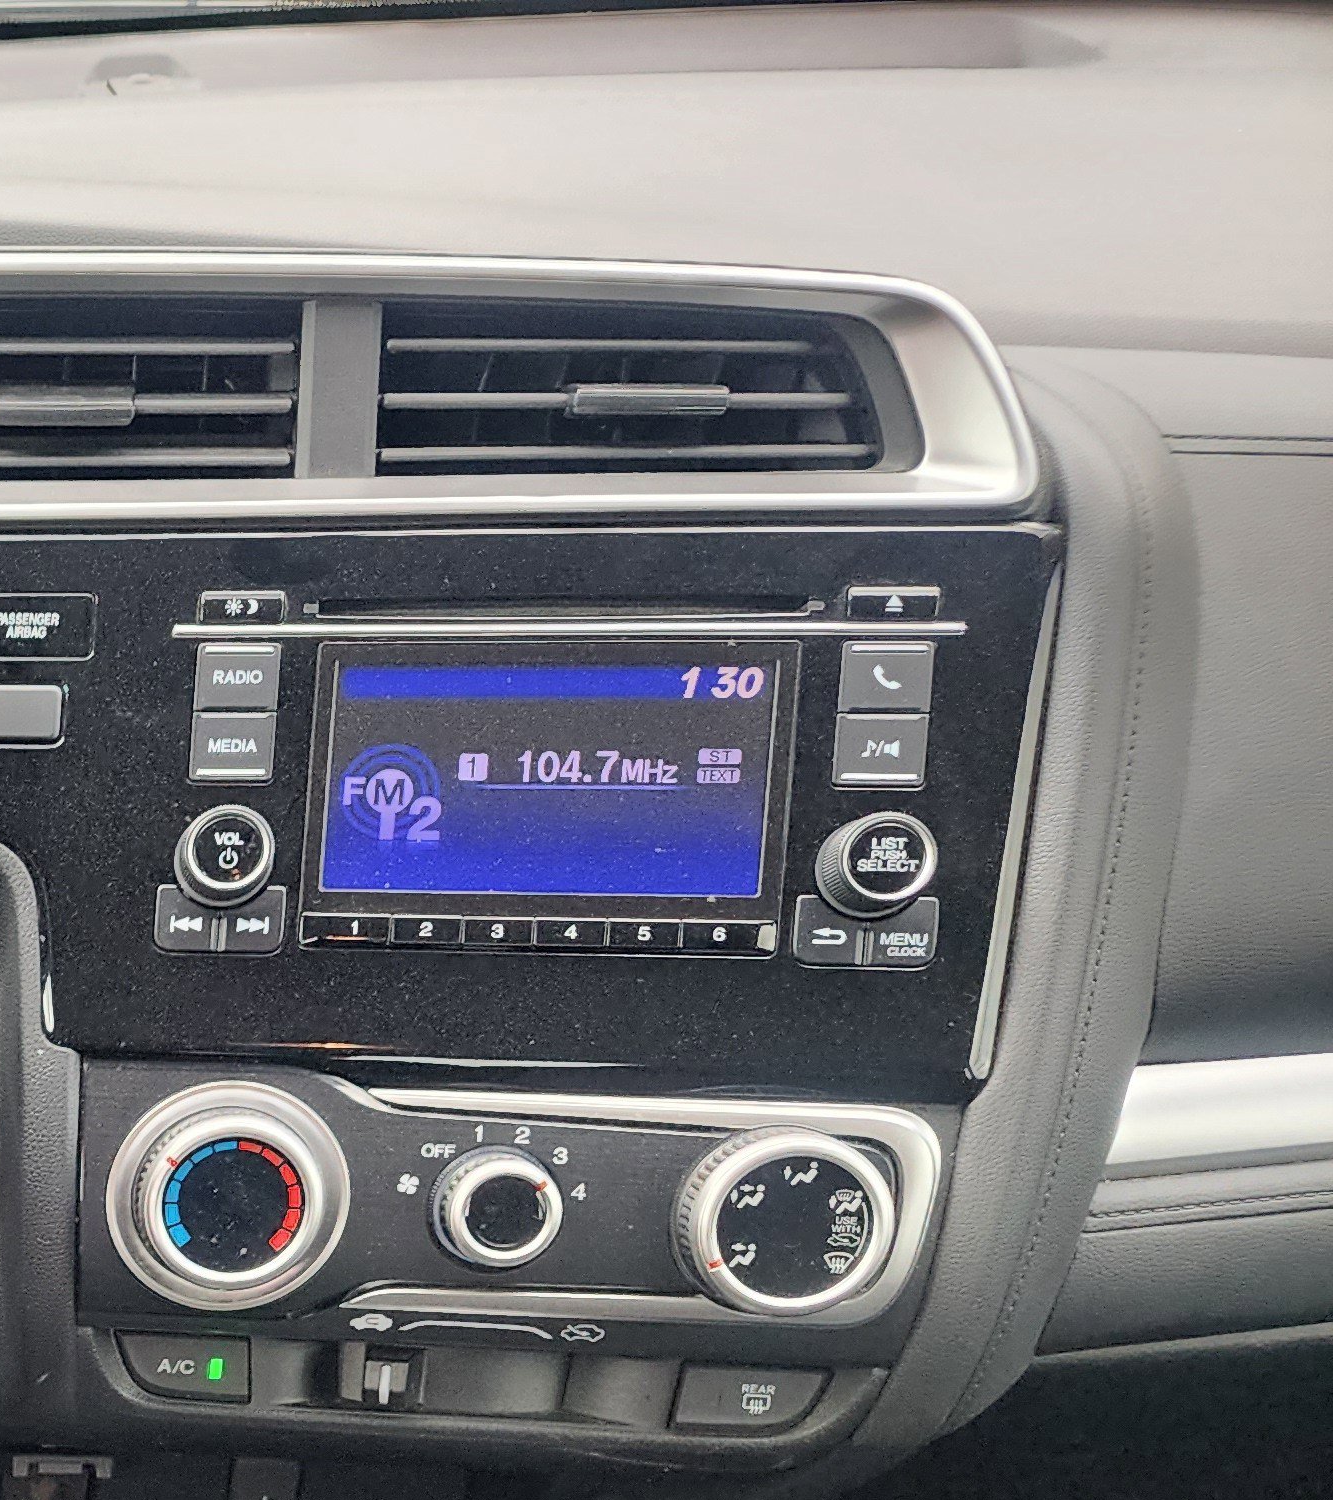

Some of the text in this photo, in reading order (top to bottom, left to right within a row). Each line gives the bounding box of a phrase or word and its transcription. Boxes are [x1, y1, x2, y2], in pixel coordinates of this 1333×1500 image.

[5, 625, 47, 639] AIRBAG
[212, 669, 263, 685] RADIO
[207, 738, 258, 753] MEDIA
[709, 750, 732, 763] ST
[701, 769, 736, 782] TEXT
[214, 831, 244, 846] VOL
[871, 837, 909, 850] LIST
[870, 850, 908, 859] PUSH
[856, 859, 919, 873] SELECT
[351, 920, 726, 942] 1 2 3 4 5 6
[880, 932, 928, 946] MENU
[886, 946, 926, 957] CLOCK
[474, 1124, 484, 1142] 1
[513, 1126, 531, 1144] 2
[420, 1143, 457, 1158] OFF
[552, 1146, 569, 1165] 3
[570, 1182, 587, 1201] 4
[835, 1216, 858, 1225] USE
[831, 1224, 861, 1233] WITH
[156, 1358, 195, 1375] A/C
[741, 1383, 776, 1395] REAR
